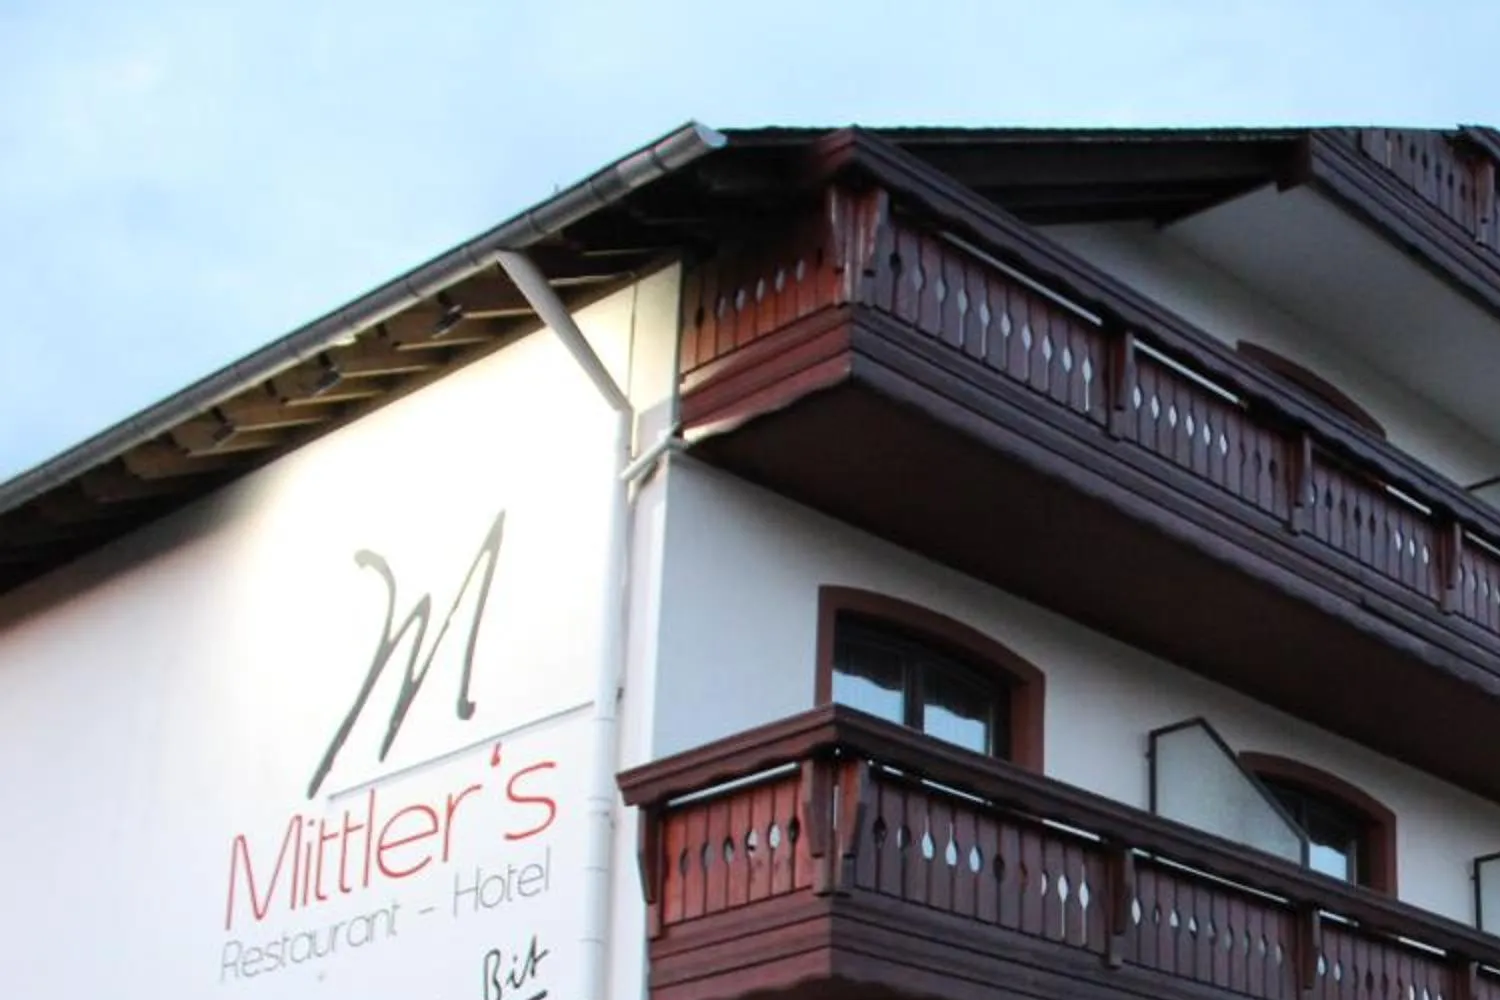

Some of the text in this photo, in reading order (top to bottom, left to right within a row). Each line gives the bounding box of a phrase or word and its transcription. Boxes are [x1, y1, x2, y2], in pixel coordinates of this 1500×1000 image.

[219, 901, 401, 983] Restaurant
[453, 847, 552, 917] Hotel
[224, 742, 557, 931] Mittler's
